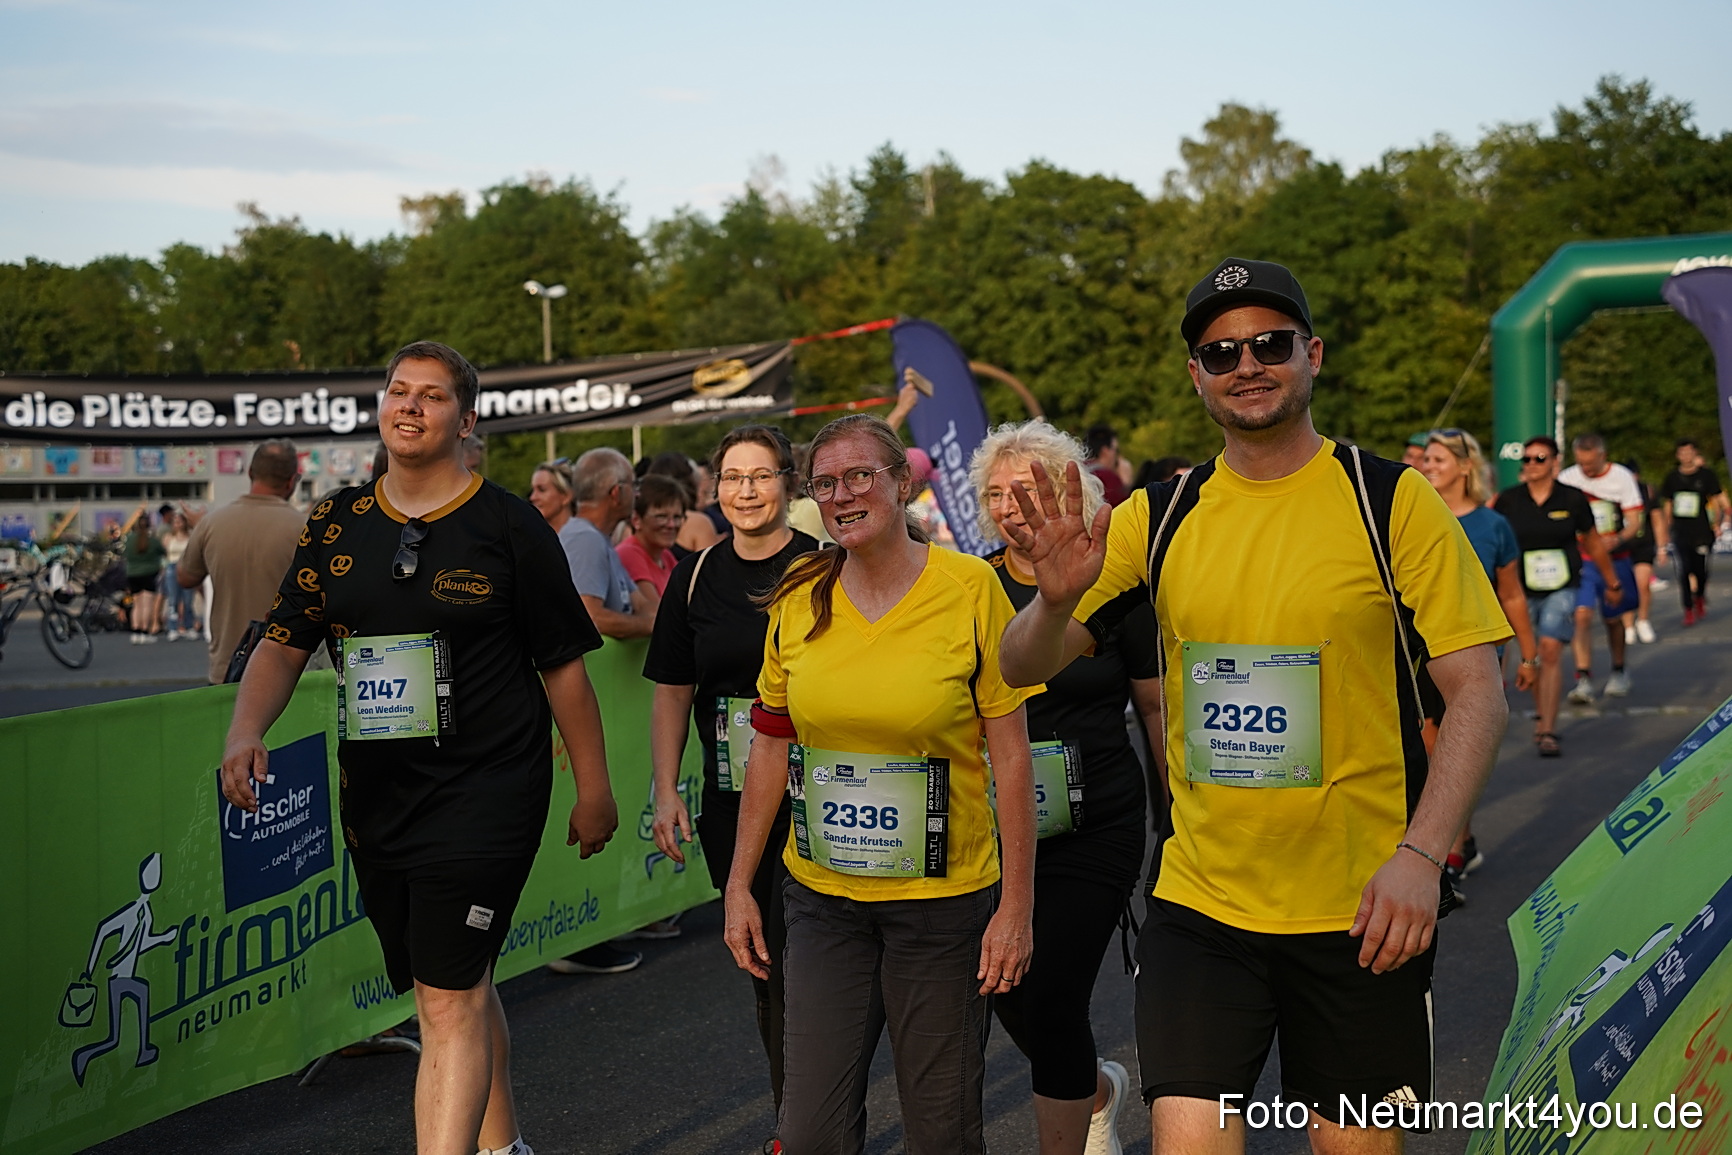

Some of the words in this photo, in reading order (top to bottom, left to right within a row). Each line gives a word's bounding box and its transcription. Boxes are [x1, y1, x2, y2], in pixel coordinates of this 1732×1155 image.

[1215, 266, 1248, 282] BRIXTON
[5, 391, 75, 427] die
[82, 392, 227, 428] Plätze.
[234, 387, 370, 434] Fertig.
[475, 379, 642, 419] nander.
[1210, 672, 1250, 681] Firmenlauf
[357, 679, 407, 701] 2147
[357, 706, 374, 715] Leon
[375, 704, 415, 714] Wedding
[440, 699, 449, 728] HILTL
[1203, 702, 1287, 734] 2326
[790, 753, 802, 761] AOK
[1210, 738, 1246, 751] Stefan
[1249, 741, 1285, 755] Bayer
[830, 776, 867, 784] Firmenlauf
[822, 801, 899, 830] 2336
[928, 801, 934, 811] 20
[251, 809, 310, 842] AUTOMOBILE
[823, 831, 858, 845] Sandra
[859, 835, 903, 848] Krutsch
[271, 846, 290, 867] und
[929, 835, 938, 870] HILTL
[177, 958, 307, 1044] neumarkt
